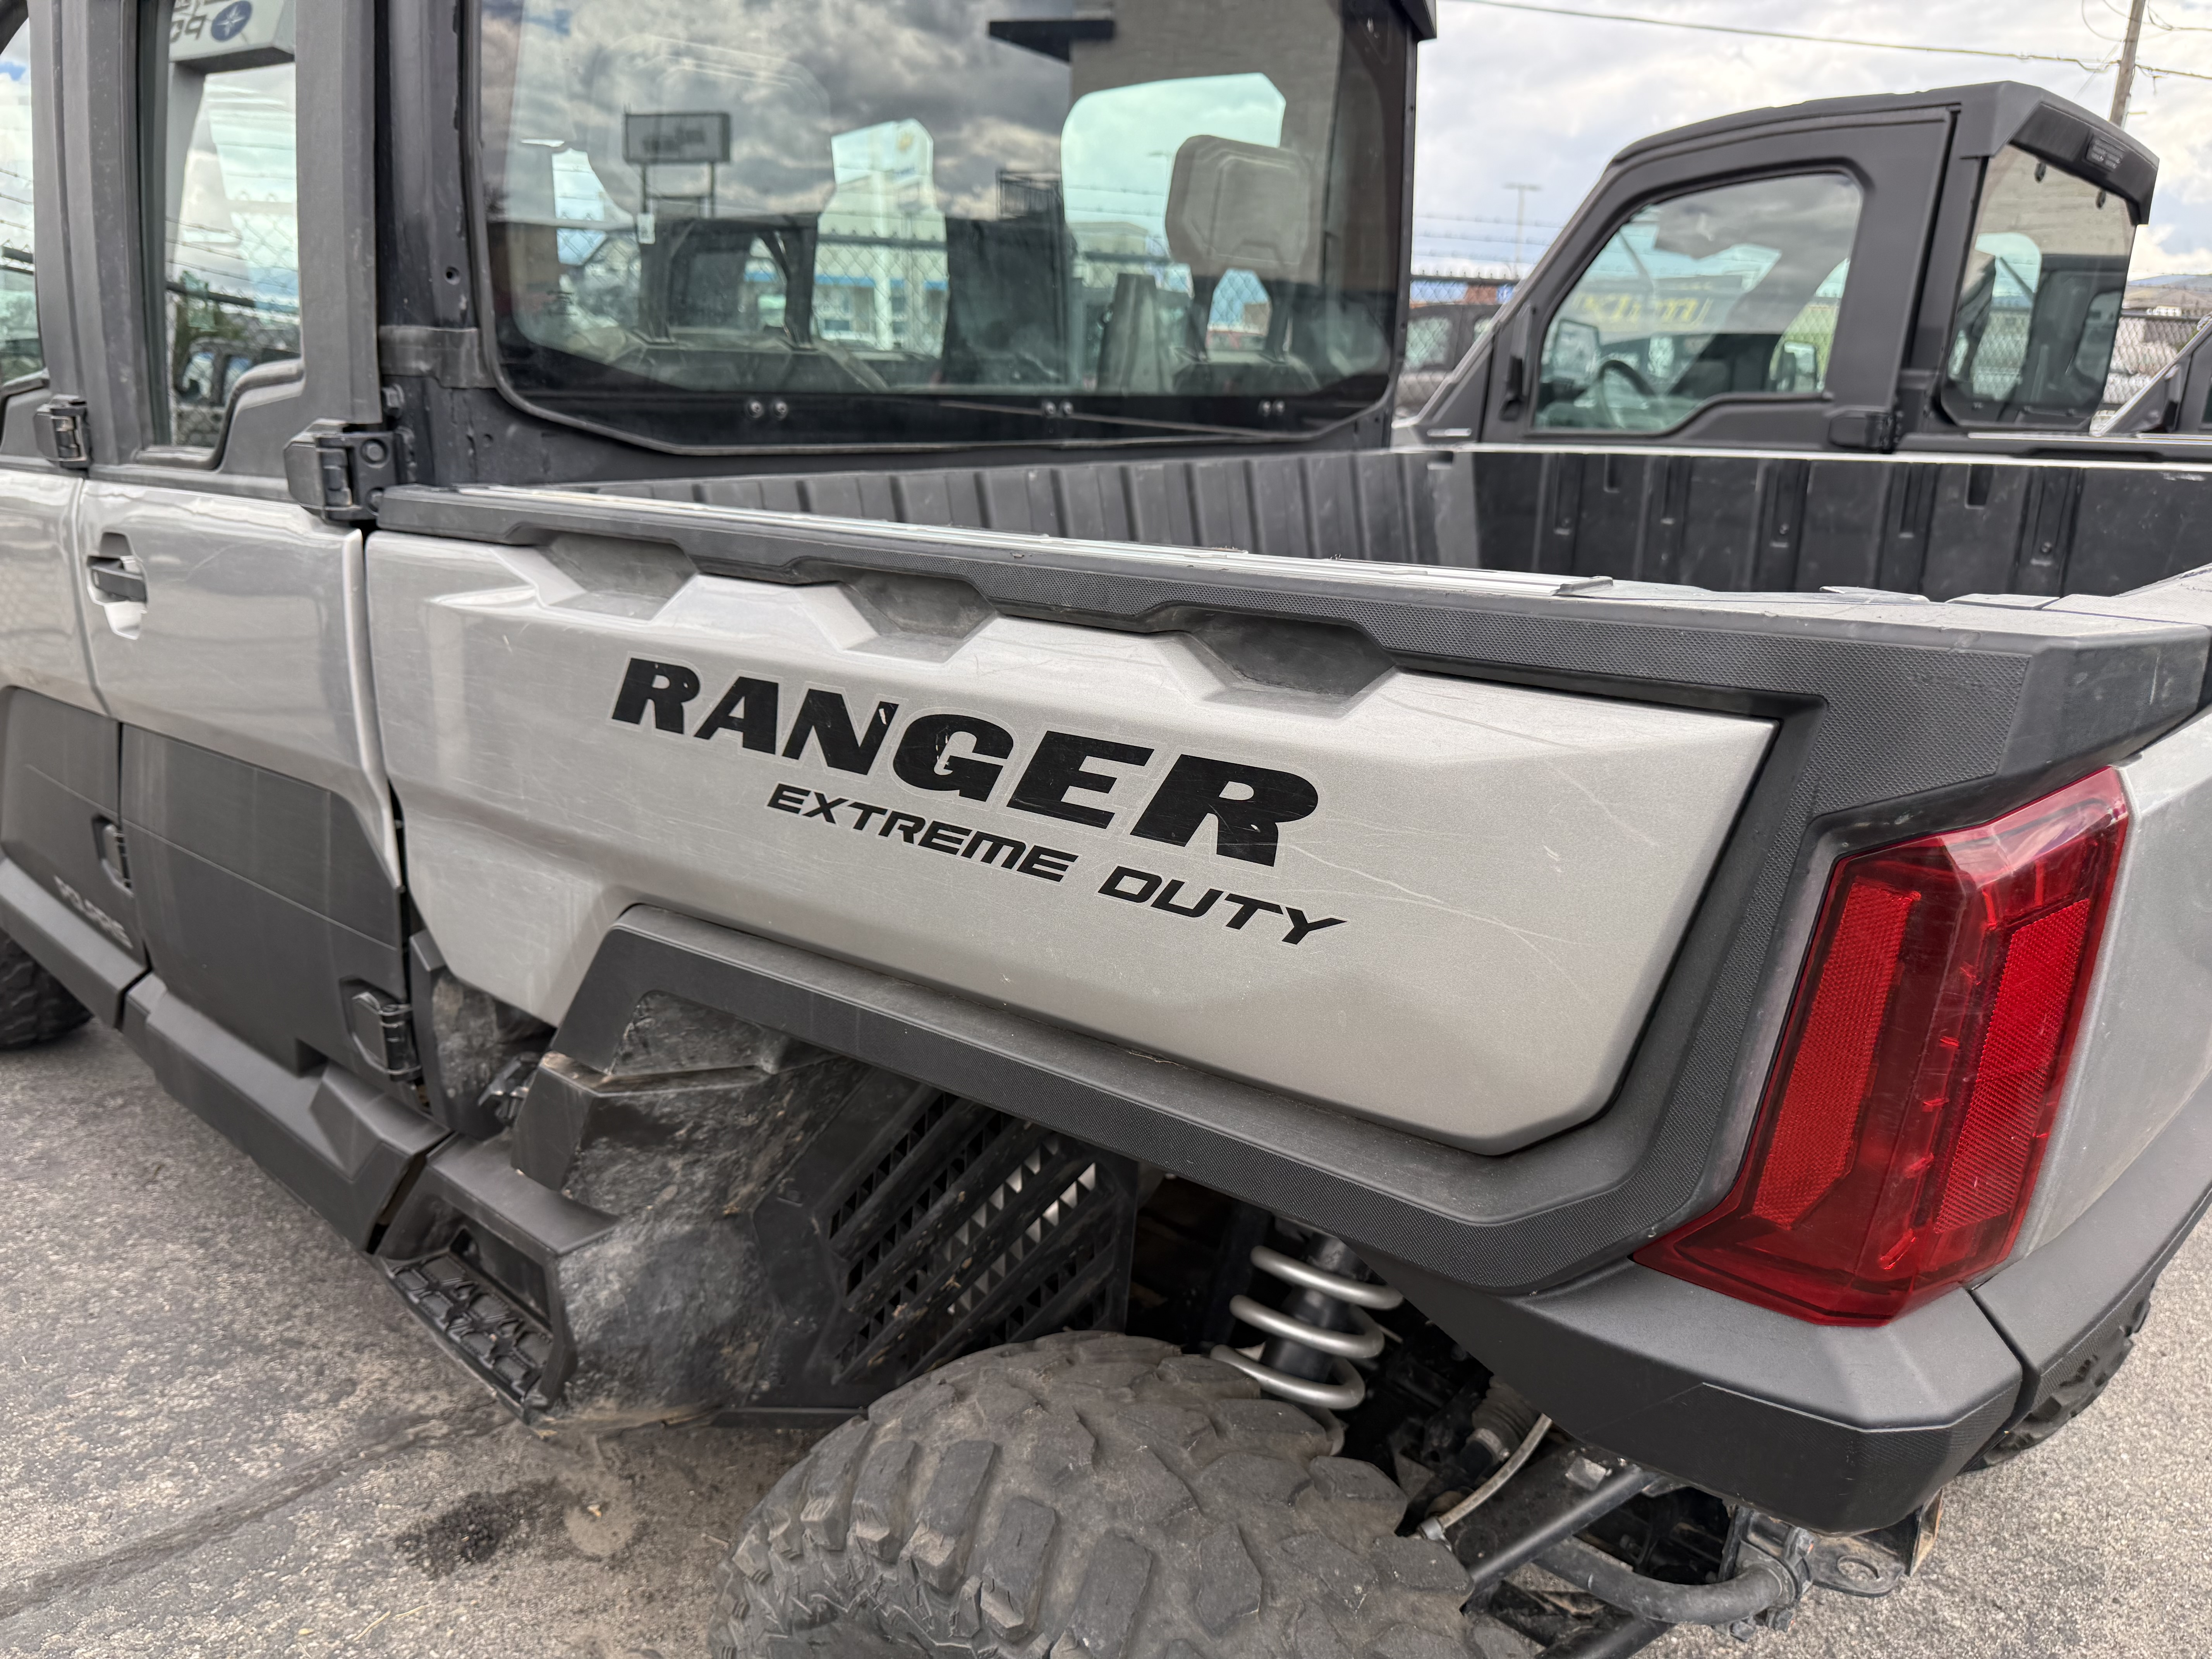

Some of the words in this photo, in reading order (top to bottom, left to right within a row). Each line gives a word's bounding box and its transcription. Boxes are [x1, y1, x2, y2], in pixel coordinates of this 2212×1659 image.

[612, 658, 1318, 867] RANGER
[767, 783, 1079, 882] EXTREME
[1097, 866, 1347, 945] DUTY
